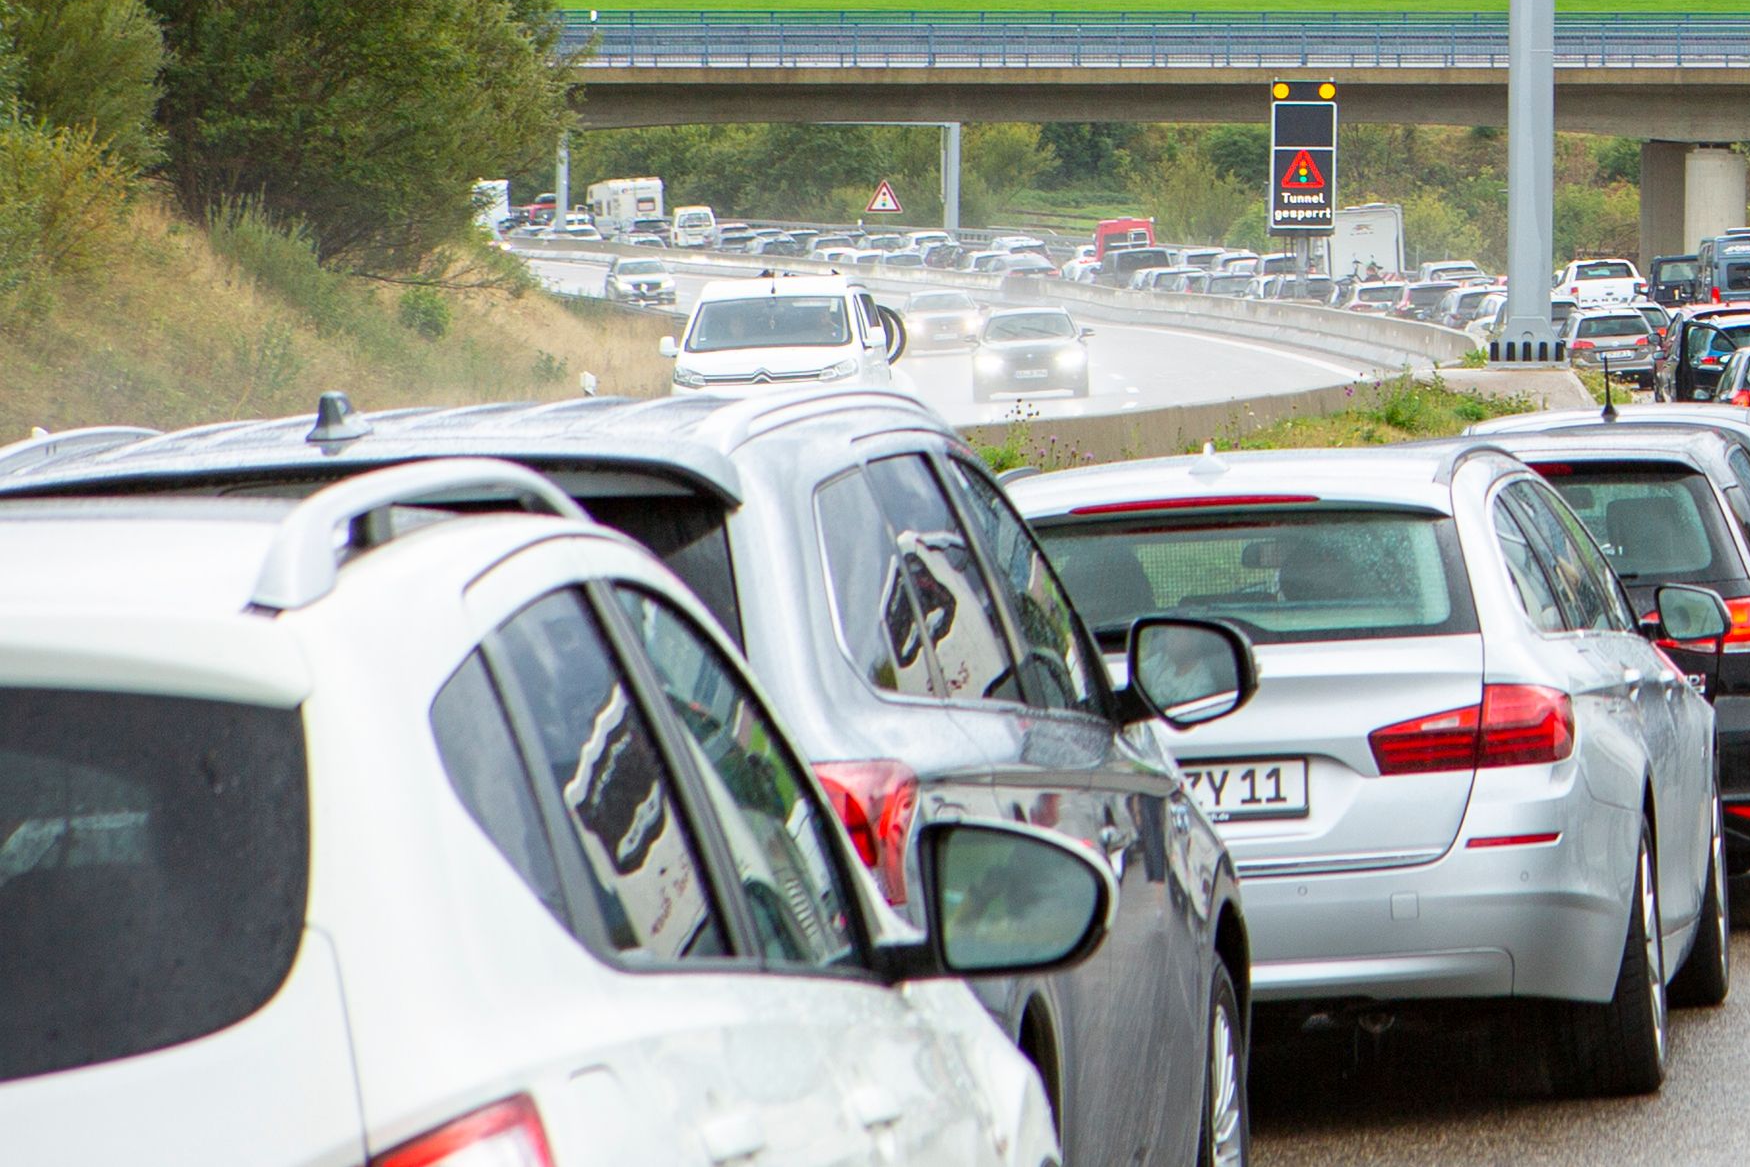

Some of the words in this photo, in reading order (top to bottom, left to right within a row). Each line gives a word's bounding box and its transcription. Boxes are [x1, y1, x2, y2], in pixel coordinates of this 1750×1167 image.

[1281, 192, 1325, 204] Tunnel
[1274, 207, 1331, 221] gesperrt
[1240, 767, 1288, 805] 11
